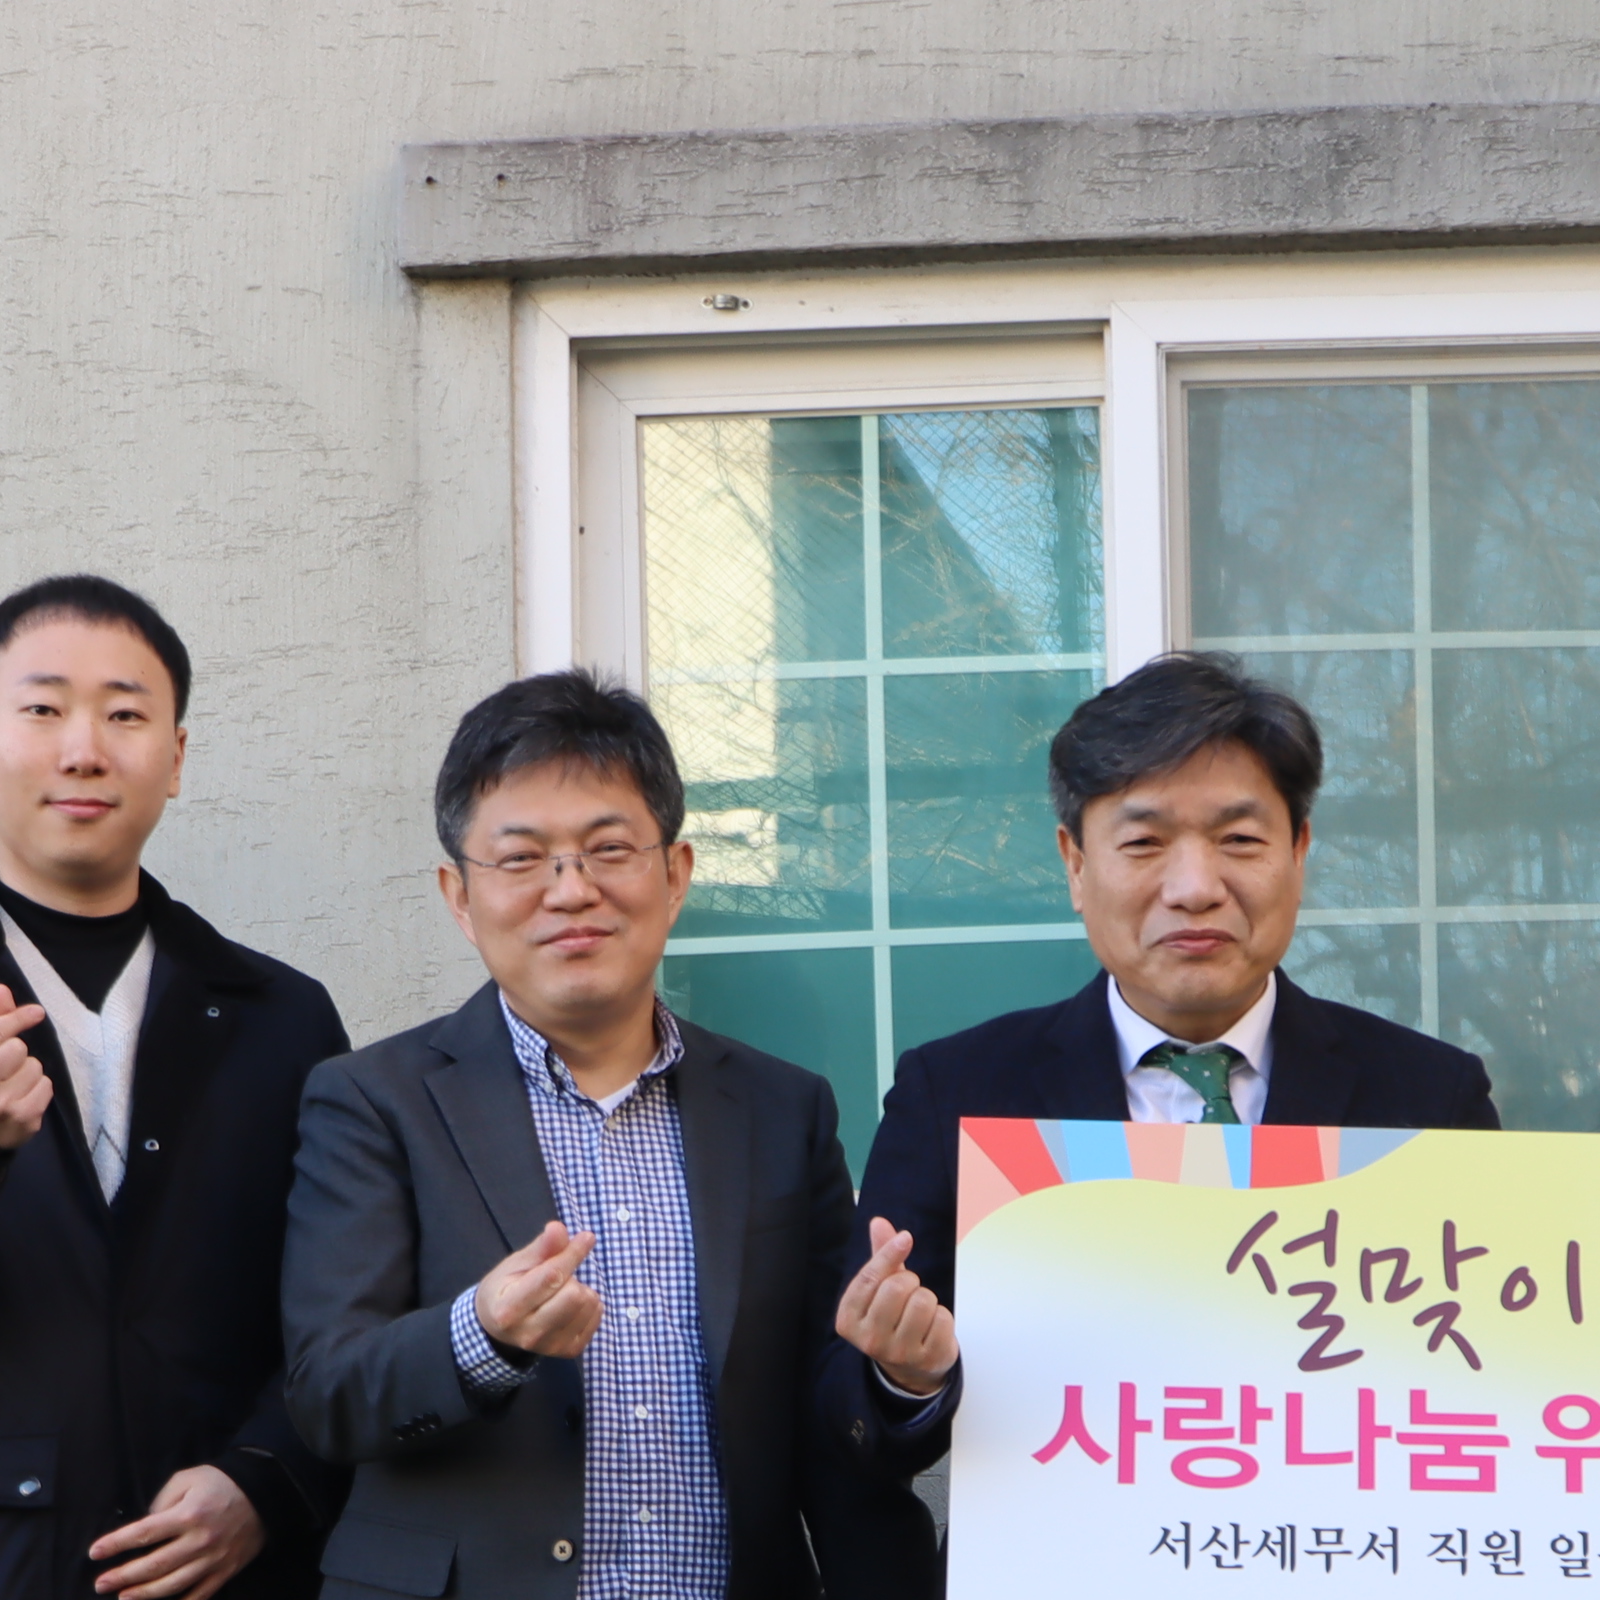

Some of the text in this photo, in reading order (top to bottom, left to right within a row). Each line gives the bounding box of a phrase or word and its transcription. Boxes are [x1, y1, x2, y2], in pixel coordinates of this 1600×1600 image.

[1226, 1208, 1584, 1373] 설맞이
[1031, 1381, 1511, 1494] 사랑나눔
[1149, 1521, 1401, 1576] 서산세무서
[1426, 1527, 1526, 1578] 직원
